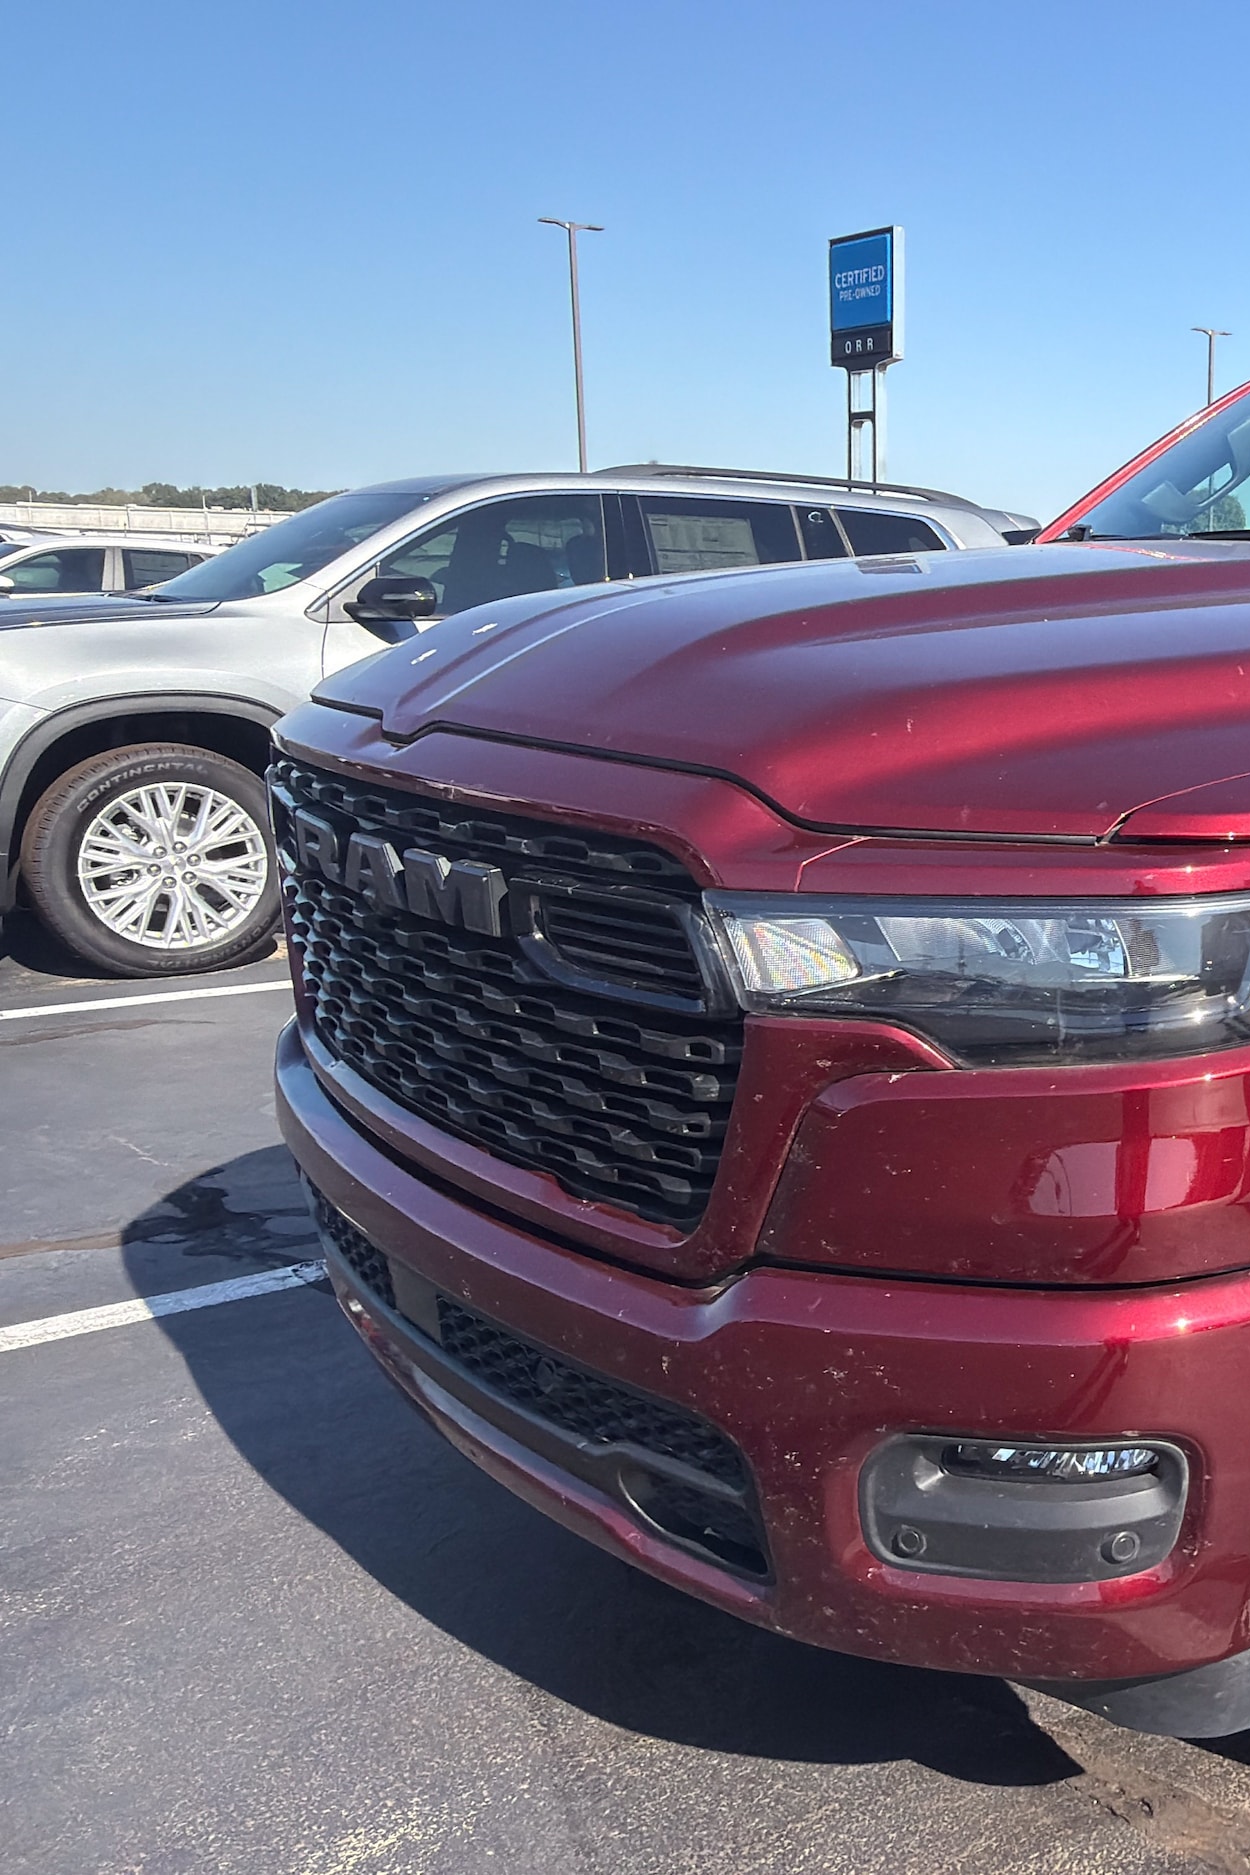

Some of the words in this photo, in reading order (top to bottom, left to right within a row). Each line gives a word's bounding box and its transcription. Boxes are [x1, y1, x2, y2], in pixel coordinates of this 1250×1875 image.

[835, 265, 885, 288] CERTIFIED
[840, 284, 881, 301] PRE-OWNED
[76, 761, 208, 814] CONTINENTAL
[294, 808, 508, 938] RAM
